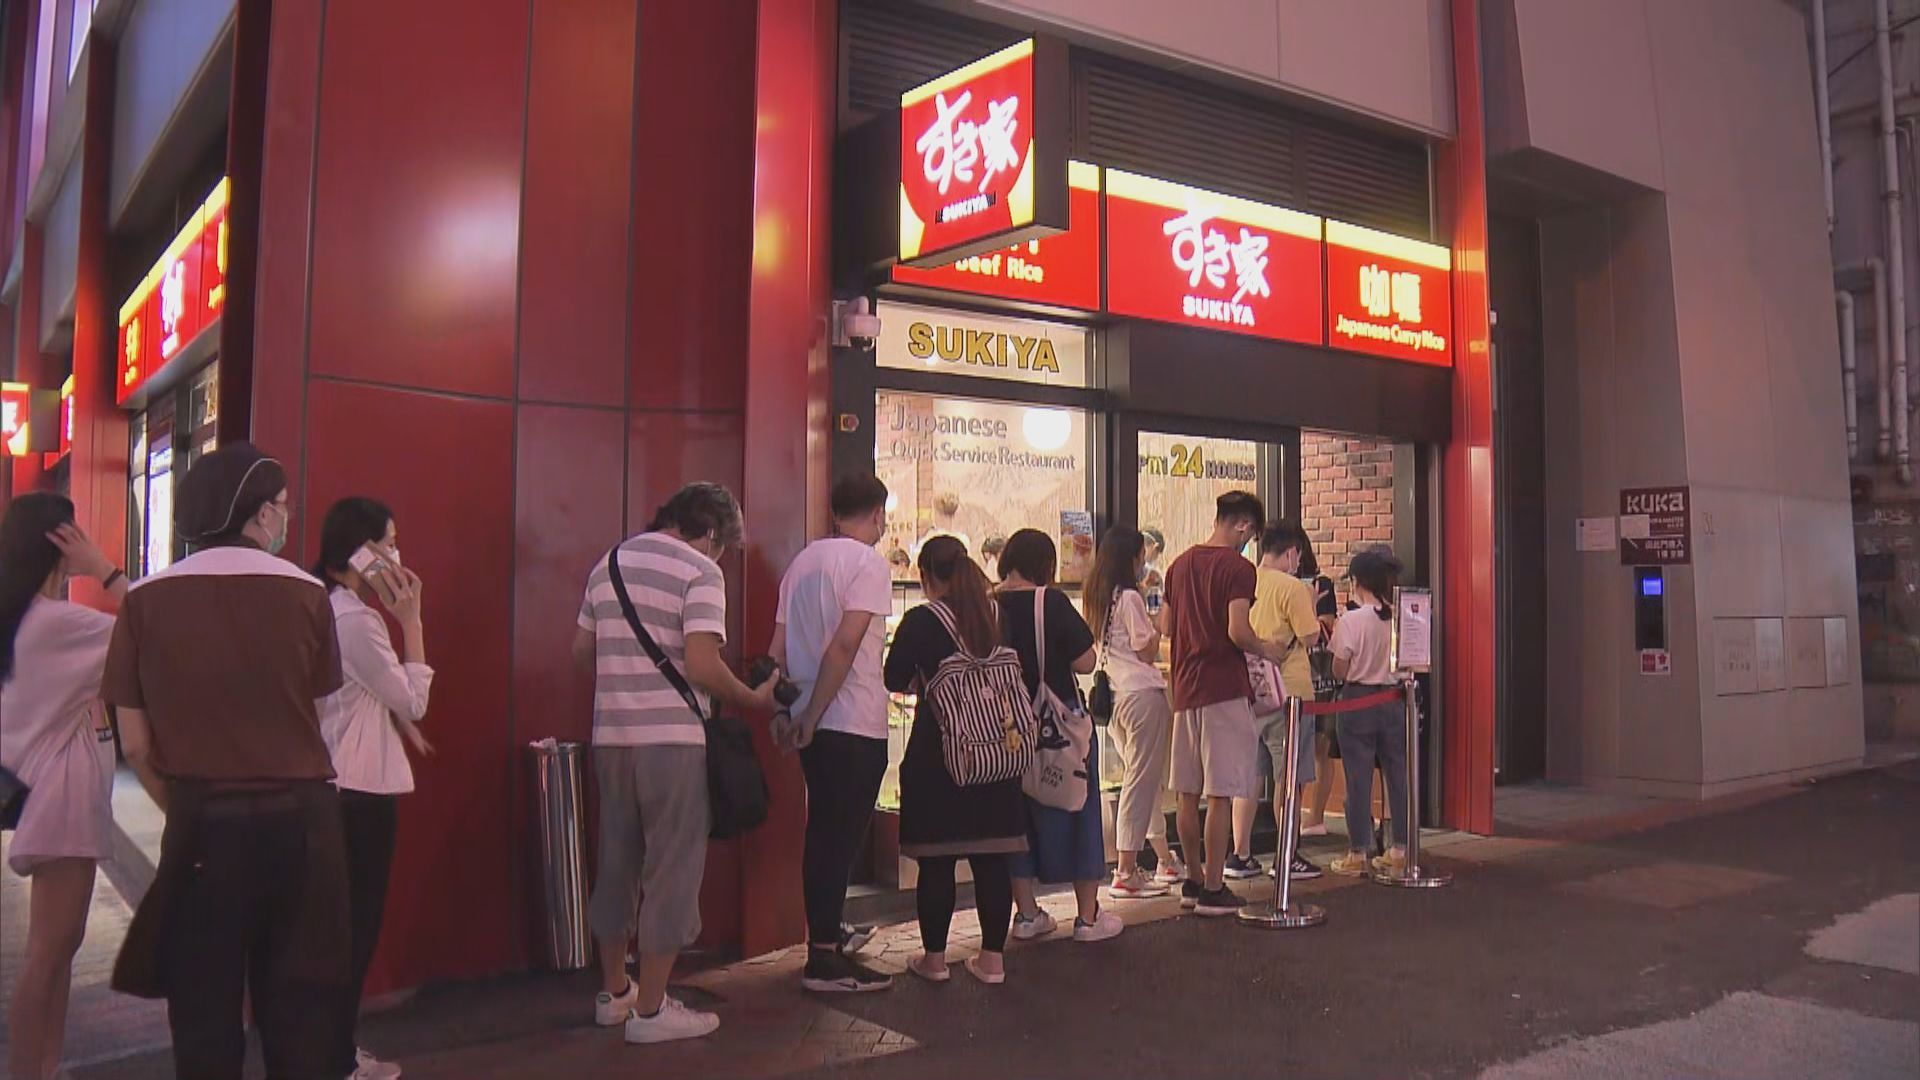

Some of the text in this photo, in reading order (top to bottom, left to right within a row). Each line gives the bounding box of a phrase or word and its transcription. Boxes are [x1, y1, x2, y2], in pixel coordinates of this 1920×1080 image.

[916, 90, 1018, 194] すき家
[942, 194, 989, 223] SUKIYA
[1163, 196, 1270, 303] すき家
[1007, 256, 1044, 283] Rice
[1182, 295, 1255, 326] SUKIYA
[908, 322, 1059, 373] SUKIYA
[1336, 313, 1445, 351] Japanese Curry Rice
[890, 403, 1007, 438] Japanese
[891, 439, 1075, 471] Quick Service Restaurant
[1170, 444, 1204, 479] 24
[1205, 460, 1256, 481] HOURS
